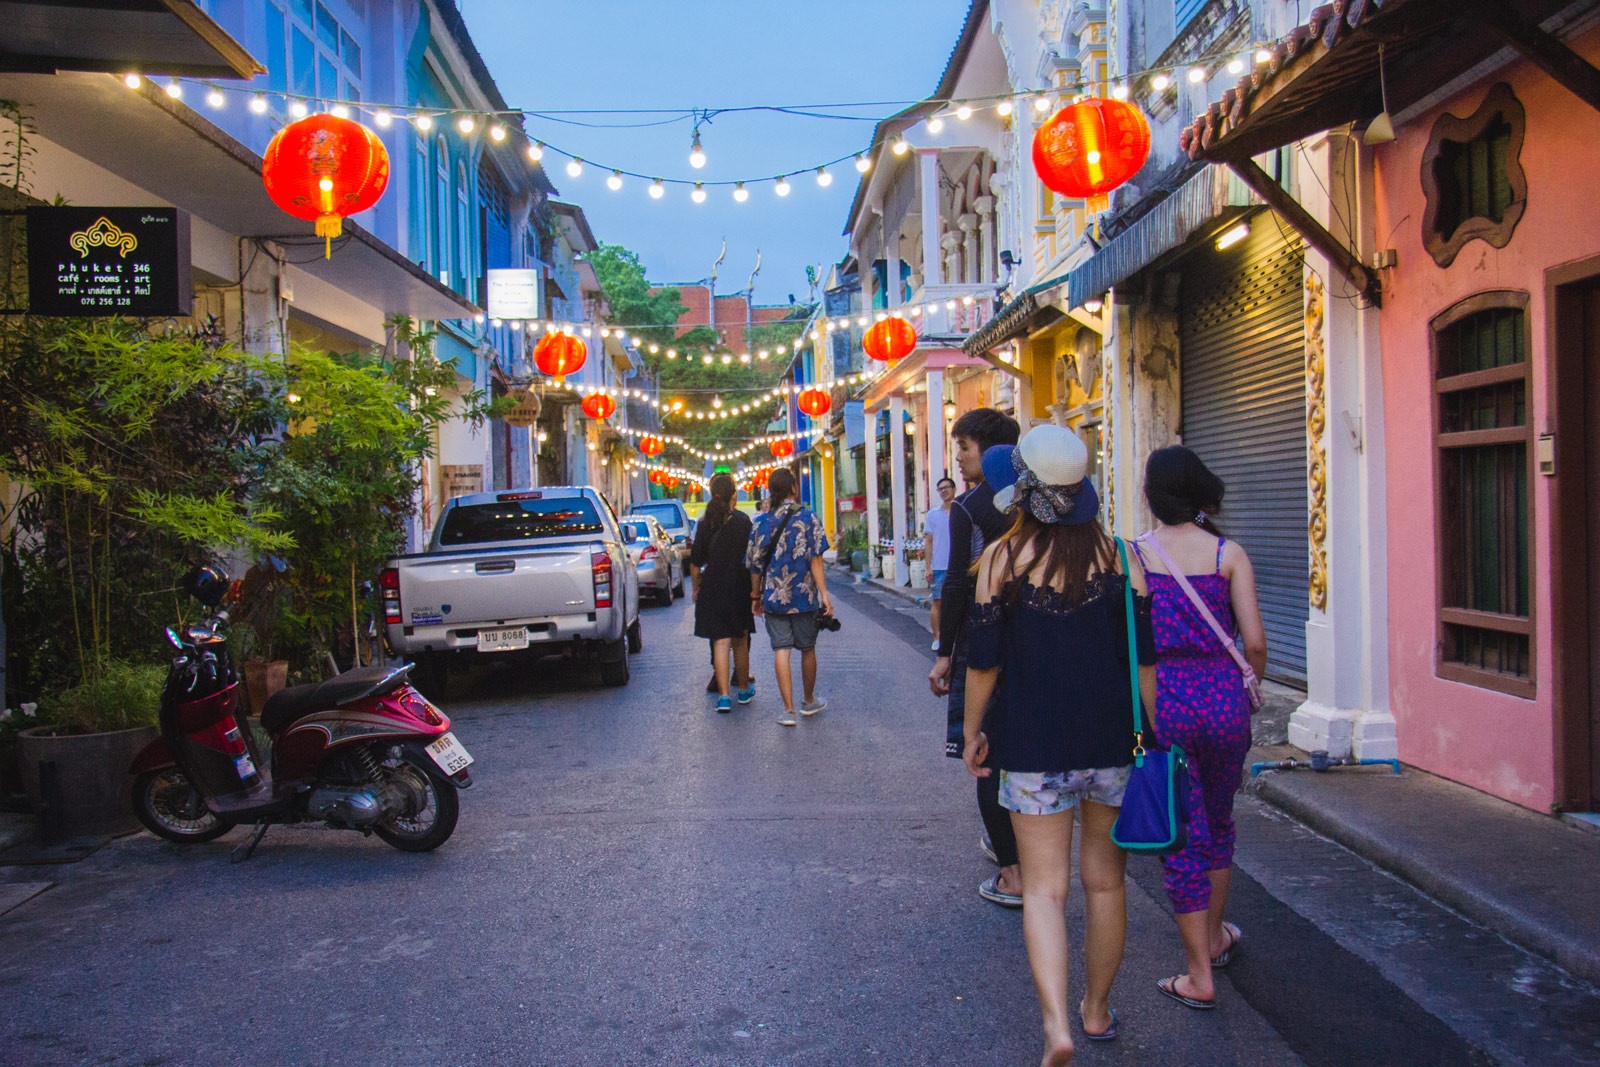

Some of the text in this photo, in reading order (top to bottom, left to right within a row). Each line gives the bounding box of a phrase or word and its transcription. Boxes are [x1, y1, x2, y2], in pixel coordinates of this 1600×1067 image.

[58, 263, 151, 273] Phuket 346
[57, 273, 151, 283] café rooms art
[81, 297, 131, 306] 076 256 128
[502, 630, 523, 640] 8068
[447, 755, 468, 772] 635
